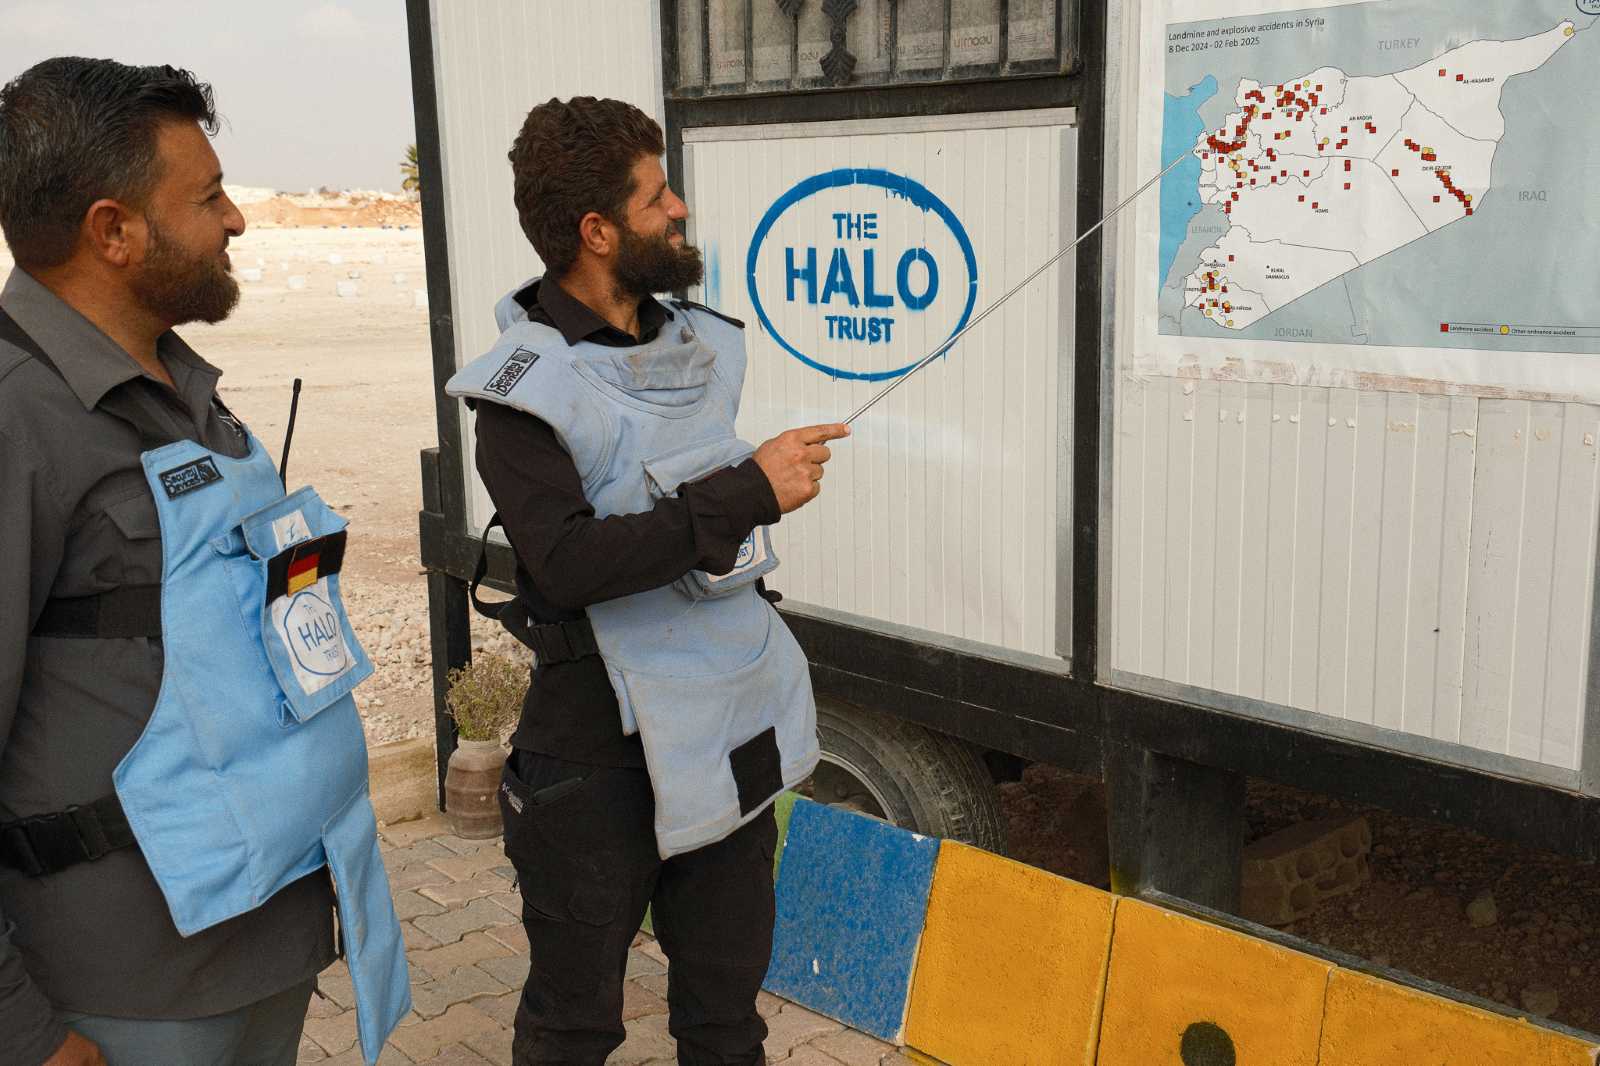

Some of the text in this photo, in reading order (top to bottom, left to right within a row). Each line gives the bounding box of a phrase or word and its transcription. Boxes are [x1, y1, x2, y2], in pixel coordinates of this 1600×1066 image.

[1168, 17, 1325, 41] Landmine and explosive accidents in Syria
[1168, 45, 1174, 53] 8
[1175, 43, 1189, 53] Dec
[1190, 42, 1209, 51] 2024
[1214, 40, 1223, 49] 02
[1224, 38, 1239, 47] Feb
[1240, 36, 1260, 46] 2025
[1377, 38, 1420, 50] TURKEY
[1519, 189, 1548, 201] IRAQ
[832, 212, 878, 240] THE
[785, 247, 940, 311] HALO
[825, 315, 895, 344] TRUST
[1274, 327, 1313, 338] JORDAN
[298, 612, 337, 651] HALO
